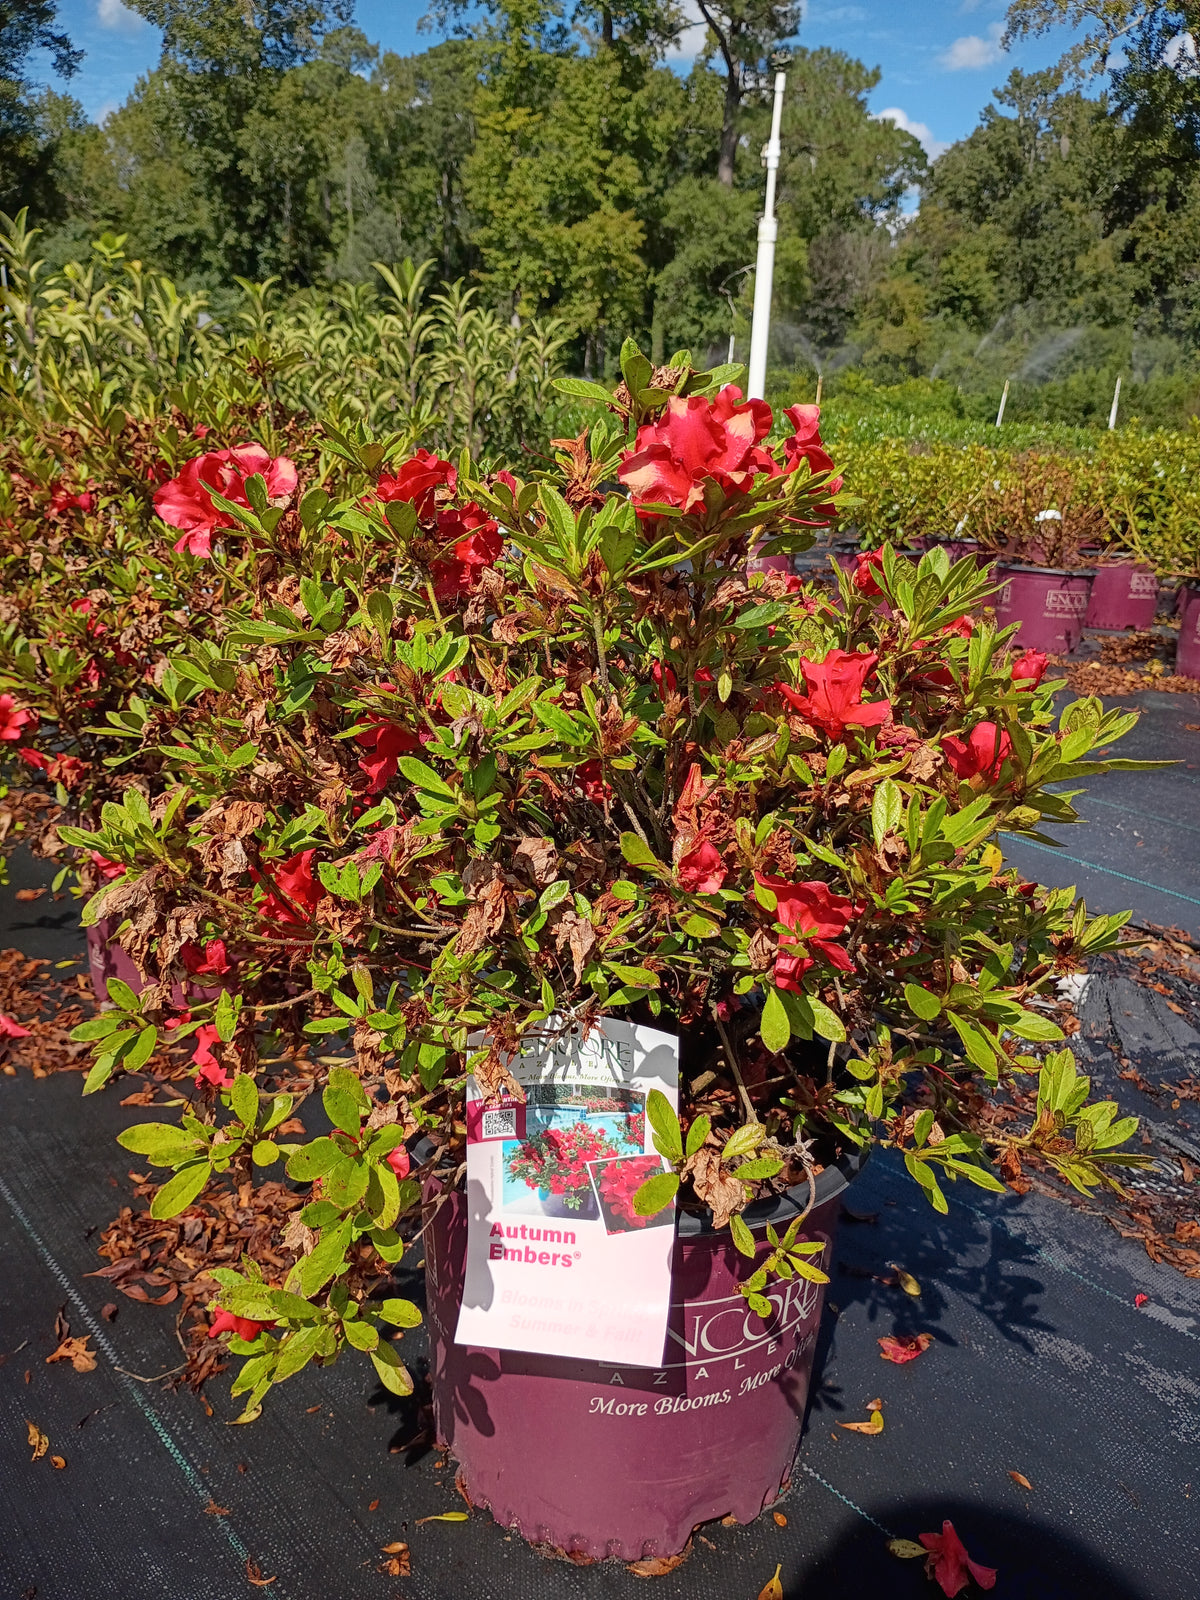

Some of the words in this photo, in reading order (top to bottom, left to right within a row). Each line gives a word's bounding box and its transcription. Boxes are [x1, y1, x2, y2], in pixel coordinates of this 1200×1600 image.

[520, 1036, 631, 1072] ENCORE
[489, 1222, 576, 1244] Autumn
[501, 1289, 565, 1311] Blooms
[668, 1278, 815, 1357] NCORE
[508, 1314, 582, 1336] Summer
[609, 1323, 801, 1385] AZALEA
[588, 1396, 649, 1417] More
[653, 1388, 732, 1415] Blooms,
[738, 1363, 782, 1396] More
